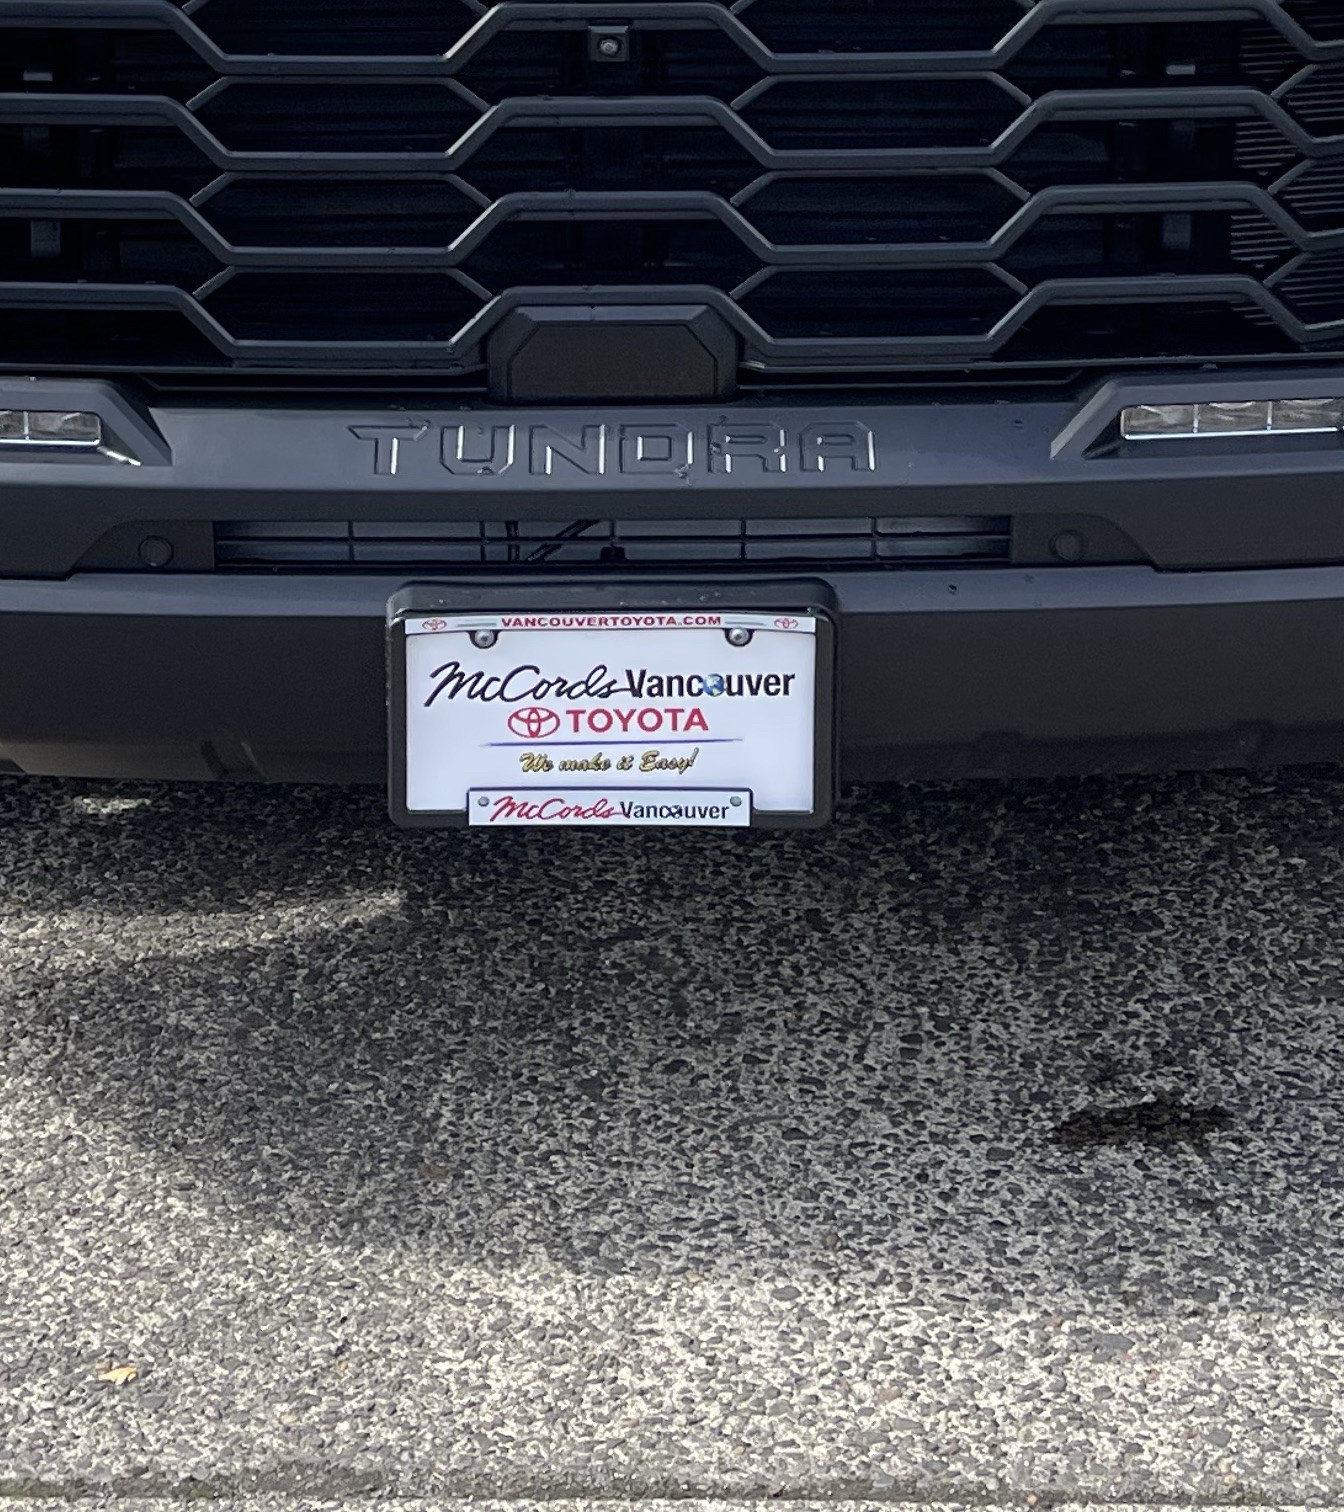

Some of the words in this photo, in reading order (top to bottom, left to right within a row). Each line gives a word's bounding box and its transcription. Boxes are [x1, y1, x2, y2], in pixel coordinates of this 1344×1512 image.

[348, 422, 877, 475] TUNDRA
[501, 615, 722, 628] VANCOUVERTOYOTA.COM
[424, 661, 628, 708] McCords
[625, 668, 796, 699] Vancouver
[566, 707, 709, 733] TOYOTA
[518, 751, 555, 773] We
[558, 751, 612, 772] make
[616, 751, 634, 772] it
[639, 747, 700, 776] Easy!
[489, 795, 622, 822] McCords
[620, 801, 729, 821] Vancouver
